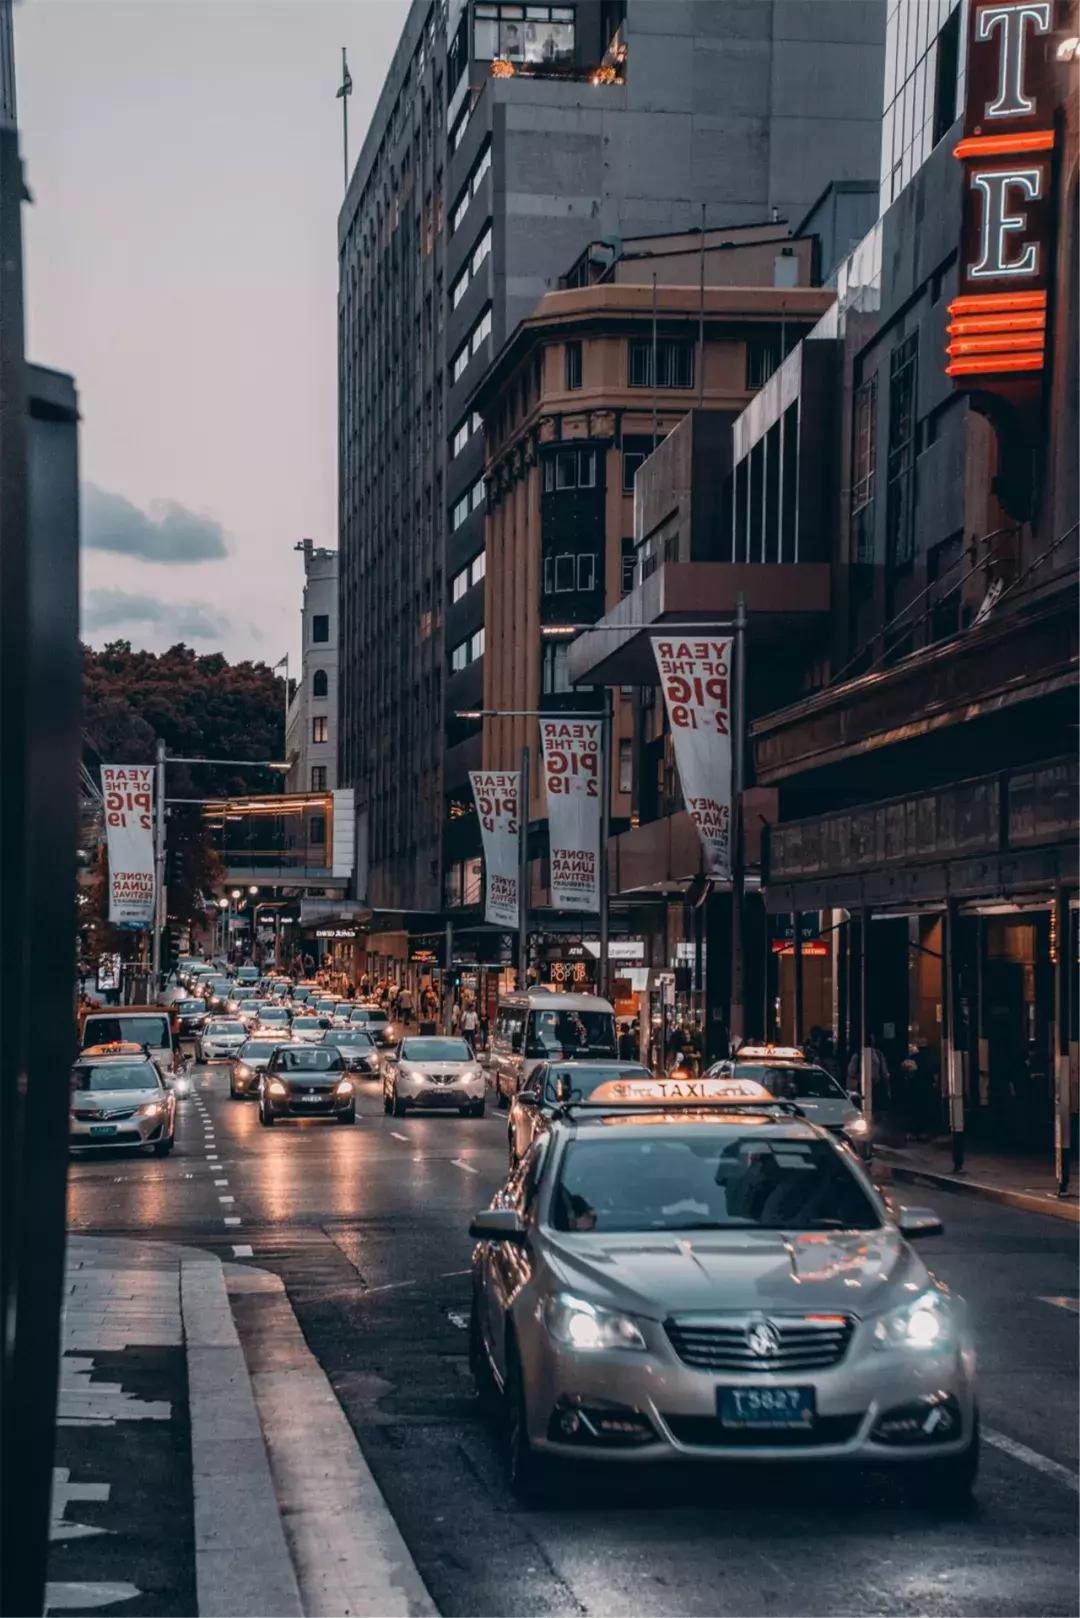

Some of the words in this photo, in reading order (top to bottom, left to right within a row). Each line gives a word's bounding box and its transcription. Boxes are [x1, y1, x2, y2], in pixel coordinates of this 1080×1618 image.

[568, 947, 584, 955] ATM
[550, 970, 571, 981] POP
[573, 970, 586, 981] UP
[657, 1084, 705, 1098] TAXI
